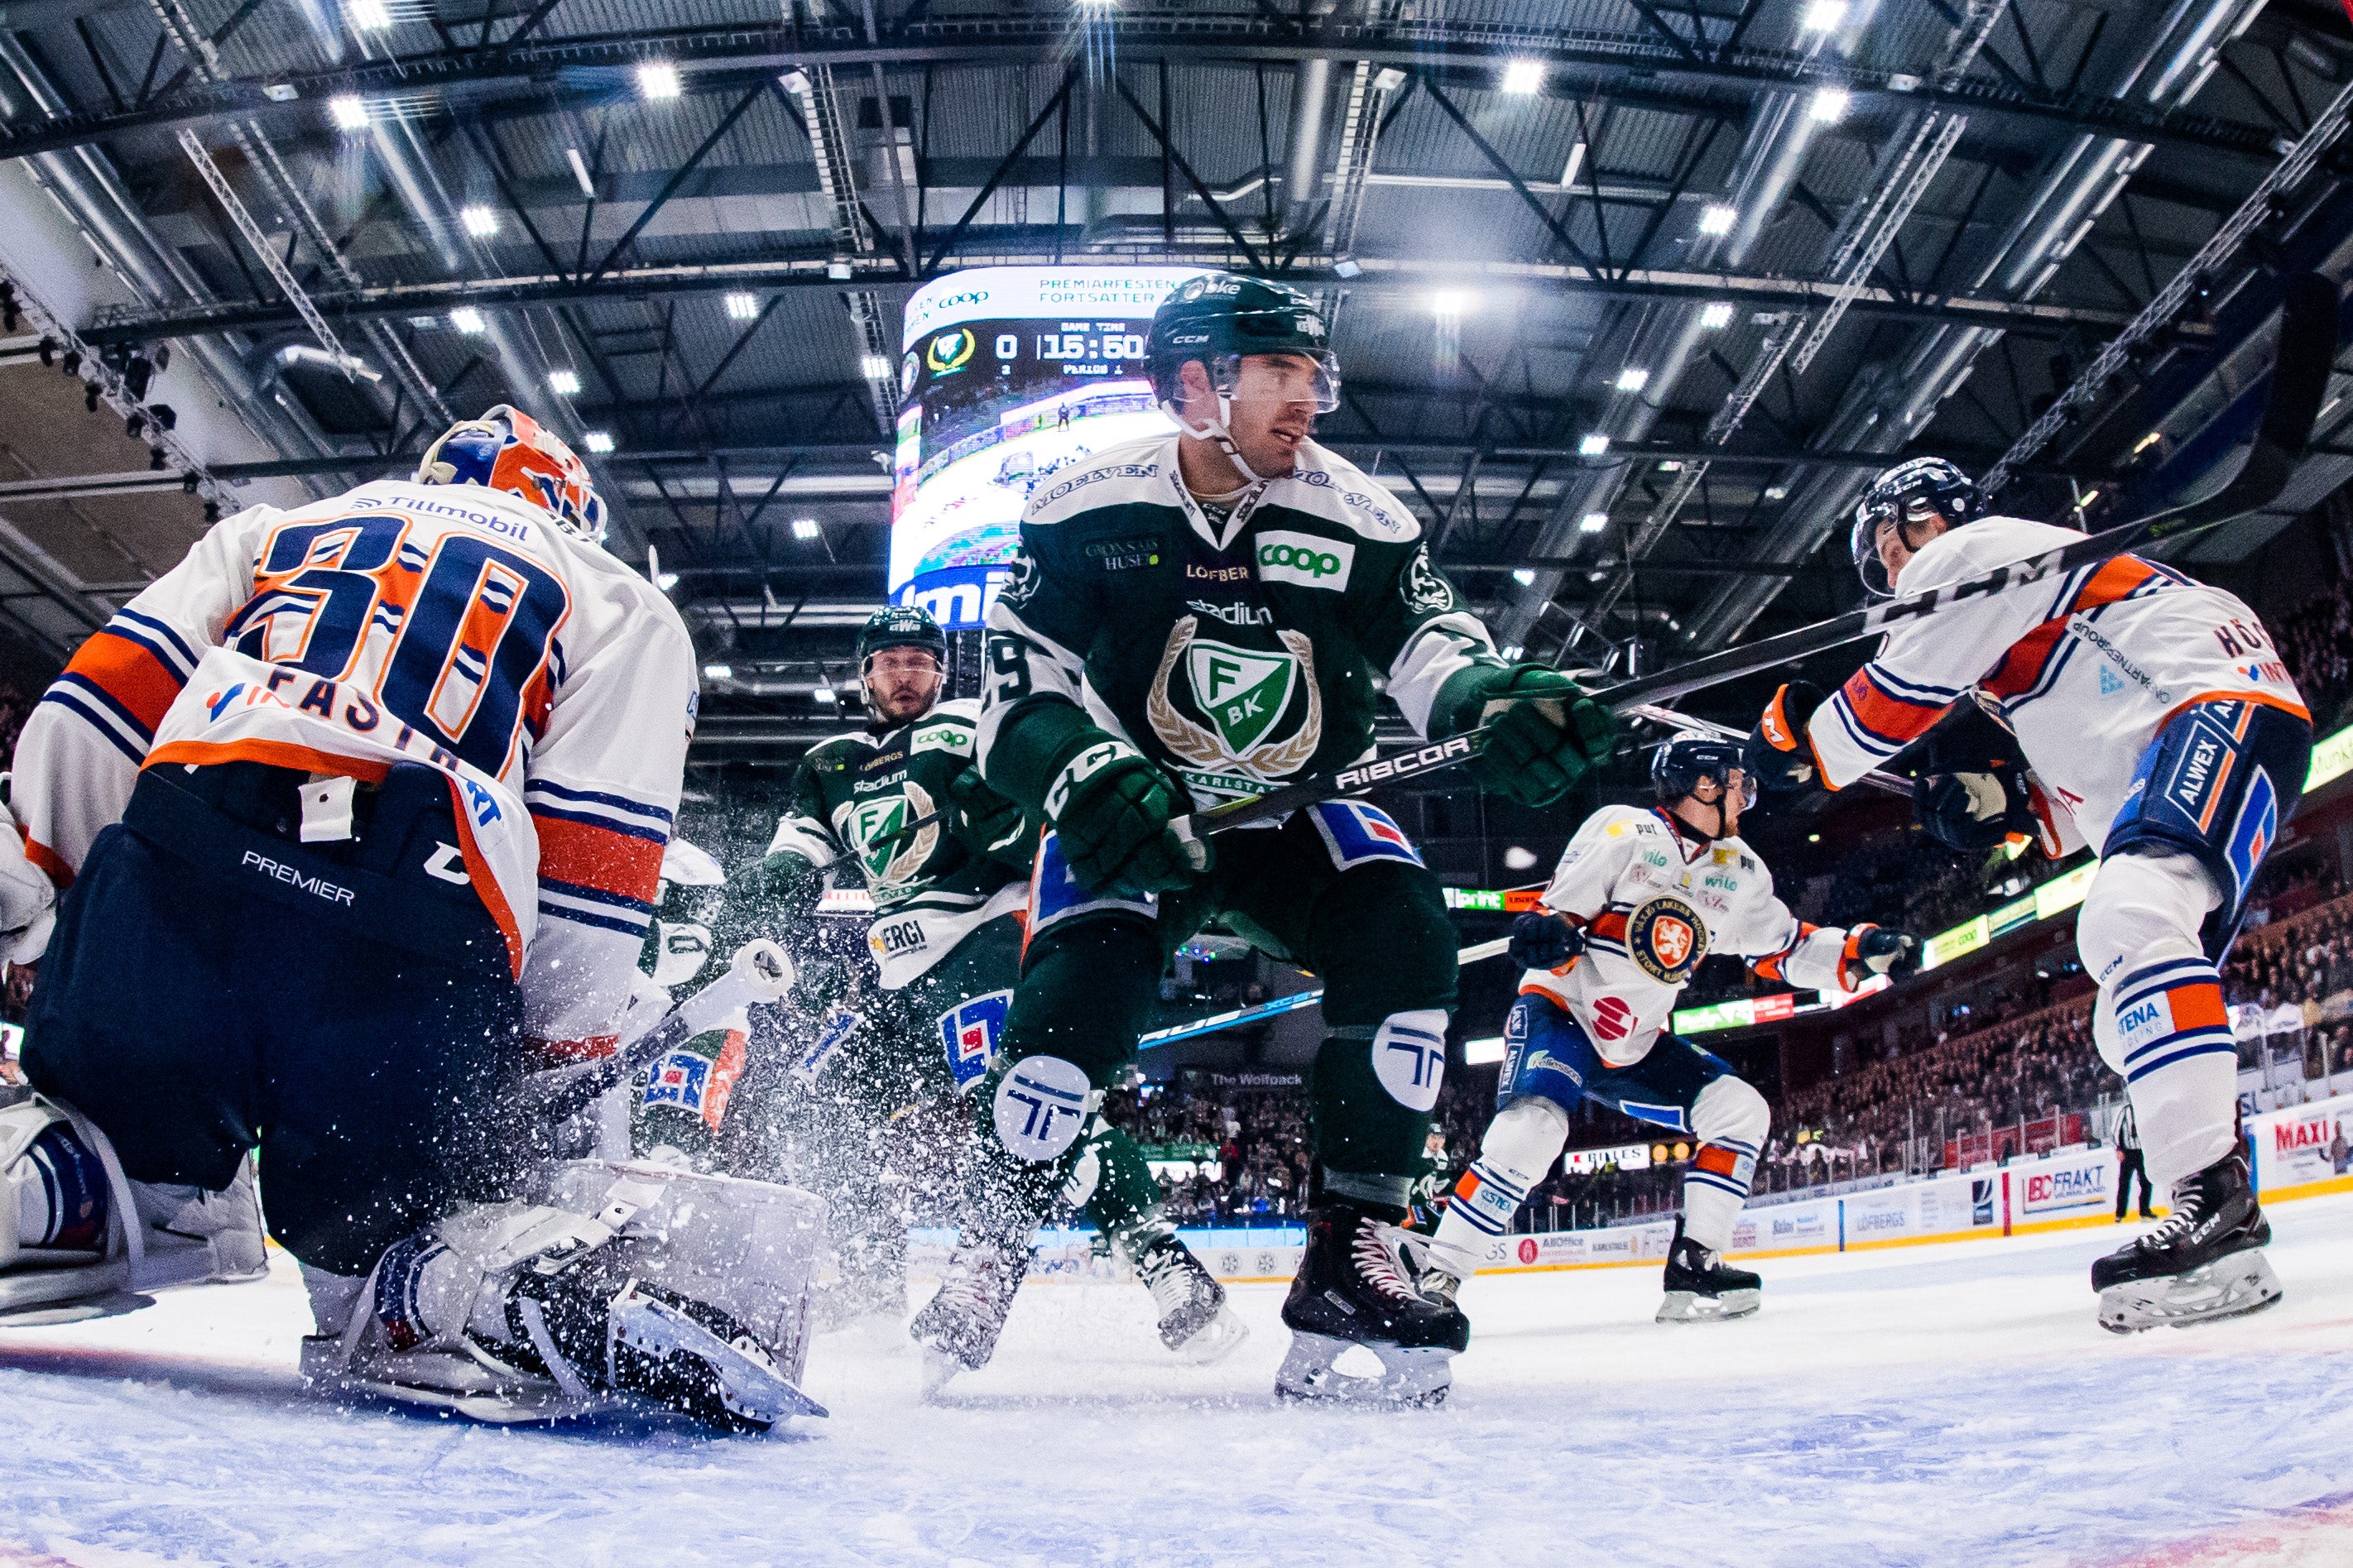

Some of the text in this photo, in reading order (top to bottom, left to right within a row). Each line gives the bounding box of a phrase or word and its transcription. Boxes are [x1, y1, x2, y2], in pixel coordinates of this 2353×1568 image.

[939, 291, 989, 309] coop
[996, 334, 1018, 359] 0
[1044, 334, 1145, 359] 15:50
[1173, 334, 1209, 343] CCM
[1031, 464, 1159, 516] MOELVEN
[387, 496, 530, 542] Tillmobil
[1259, 544, 1341, 578] coop
[223, 511, 571, 781] 30
[992, 638, 1032, 702] 9
[1227, 688, 1265, 726] BK
[916, 729, 968, 748] coop
[1335, 736, 1471, 789] RIBCOR
[2178, 741, 2218, 806] ALWEX
[853, 770, 908, 794] stadium
[242, 851, 356, 907] PREMIER
[2274, 1119, 2329, 1153] MAXI
[2028, 1165, 2106, 1203] BC FRAKT
[2190, 1211, 2221, 1244] CCM
